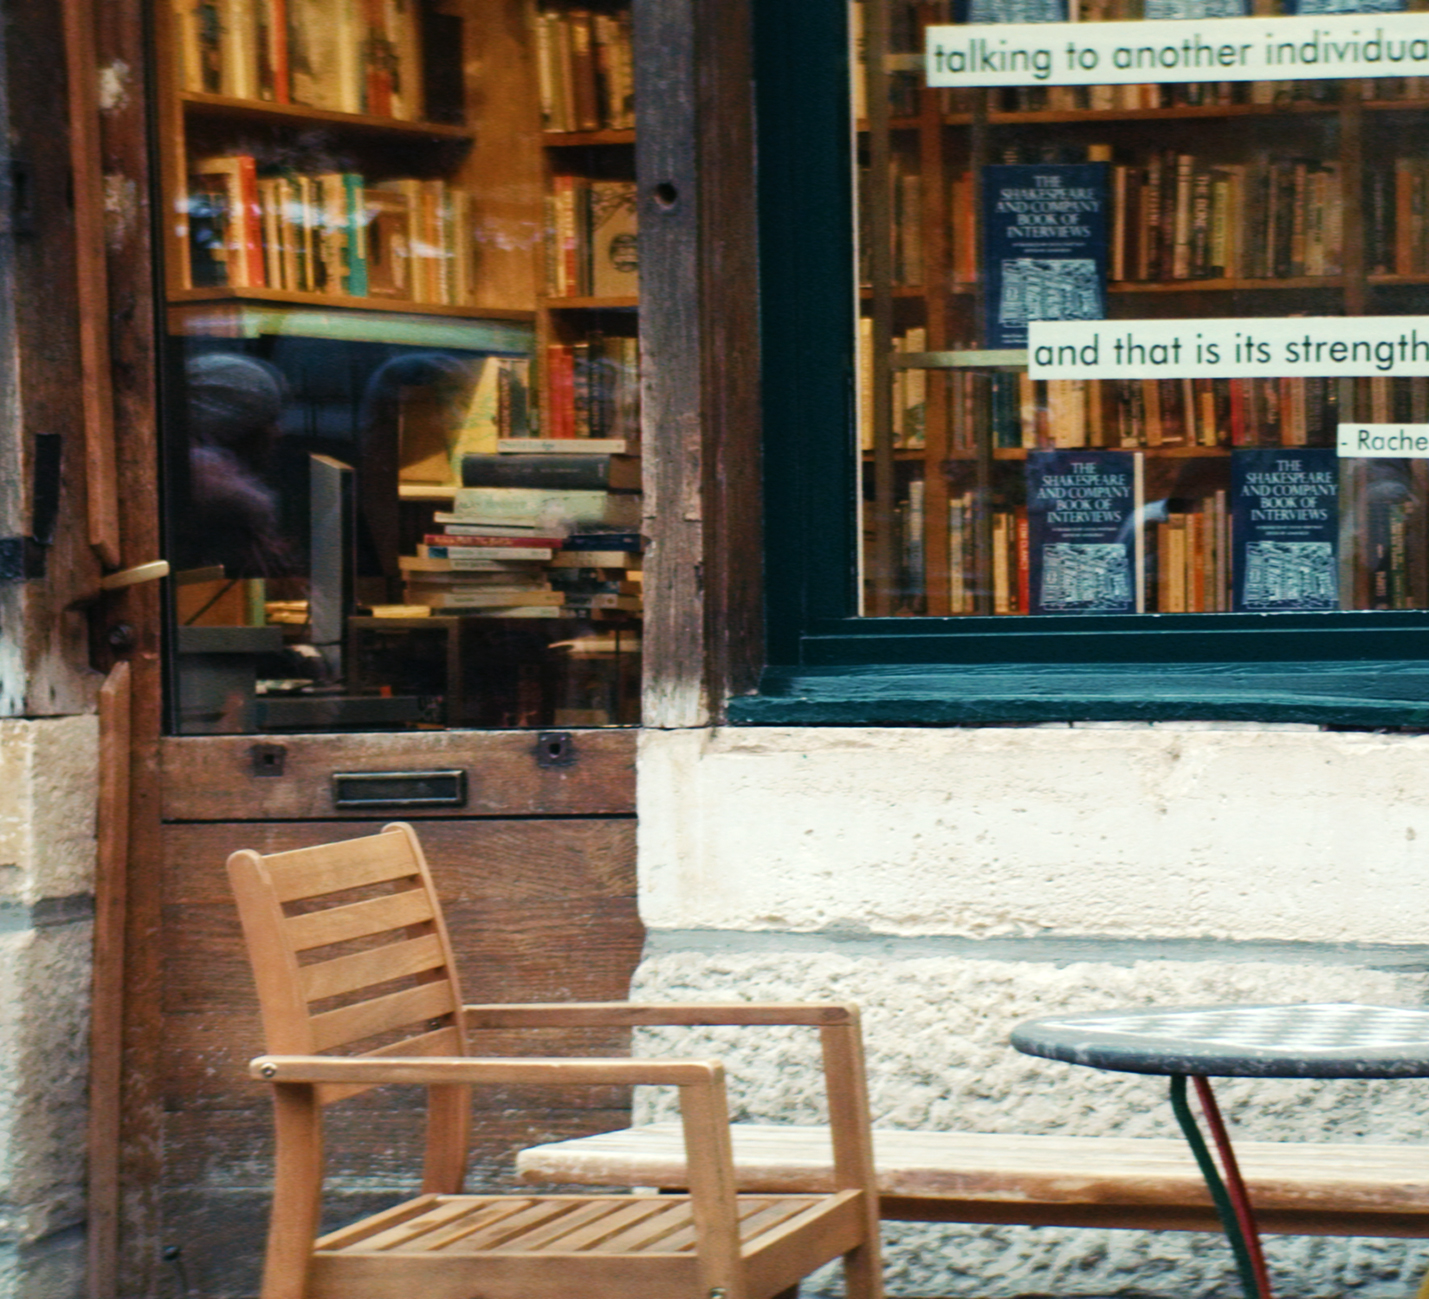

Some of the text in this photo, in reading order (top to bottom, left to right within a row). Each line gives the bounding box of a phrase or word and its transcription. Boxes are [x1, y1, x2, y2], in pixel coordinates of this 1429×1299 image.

[933, 39, 1052, 80] talking
[1066, 43, 1099, 71] to
[1113, 36, 1254, 70] another
[1033, 175, 1062, 188] THE
[995, 201, 1100, 213] AND COMPANY
[1017, 214, 1079, 225] BOOK OF
[1006, 226, 1091, 238] INTERVIEWS
[1034, 334, 1099, 366] and
[1113, 333, 1182, 364] that
[1196, 334, 1221, 364] is
[1233, 333, 1273, 364] its
[1070, 462, 1097, 474] THE
[1276, 460, 1302, 471] THE
[1042, 474, 1126, 486] SHAKESPEARE
[1245, 472, 1333, 484] SHAKESPEARE
[1037, 486, 1131, 499] AND COMPANY
[1241, 484, 1338, 496] AND COMPANY
[1056, 499, 1112, 510] BOOK OF
[1261, 497, 1318, 509] BOOK OF
[1047, 511, 1122, 523] INTERVIEWS
[1251, 509, 1328, 521] INTERVIEWS
